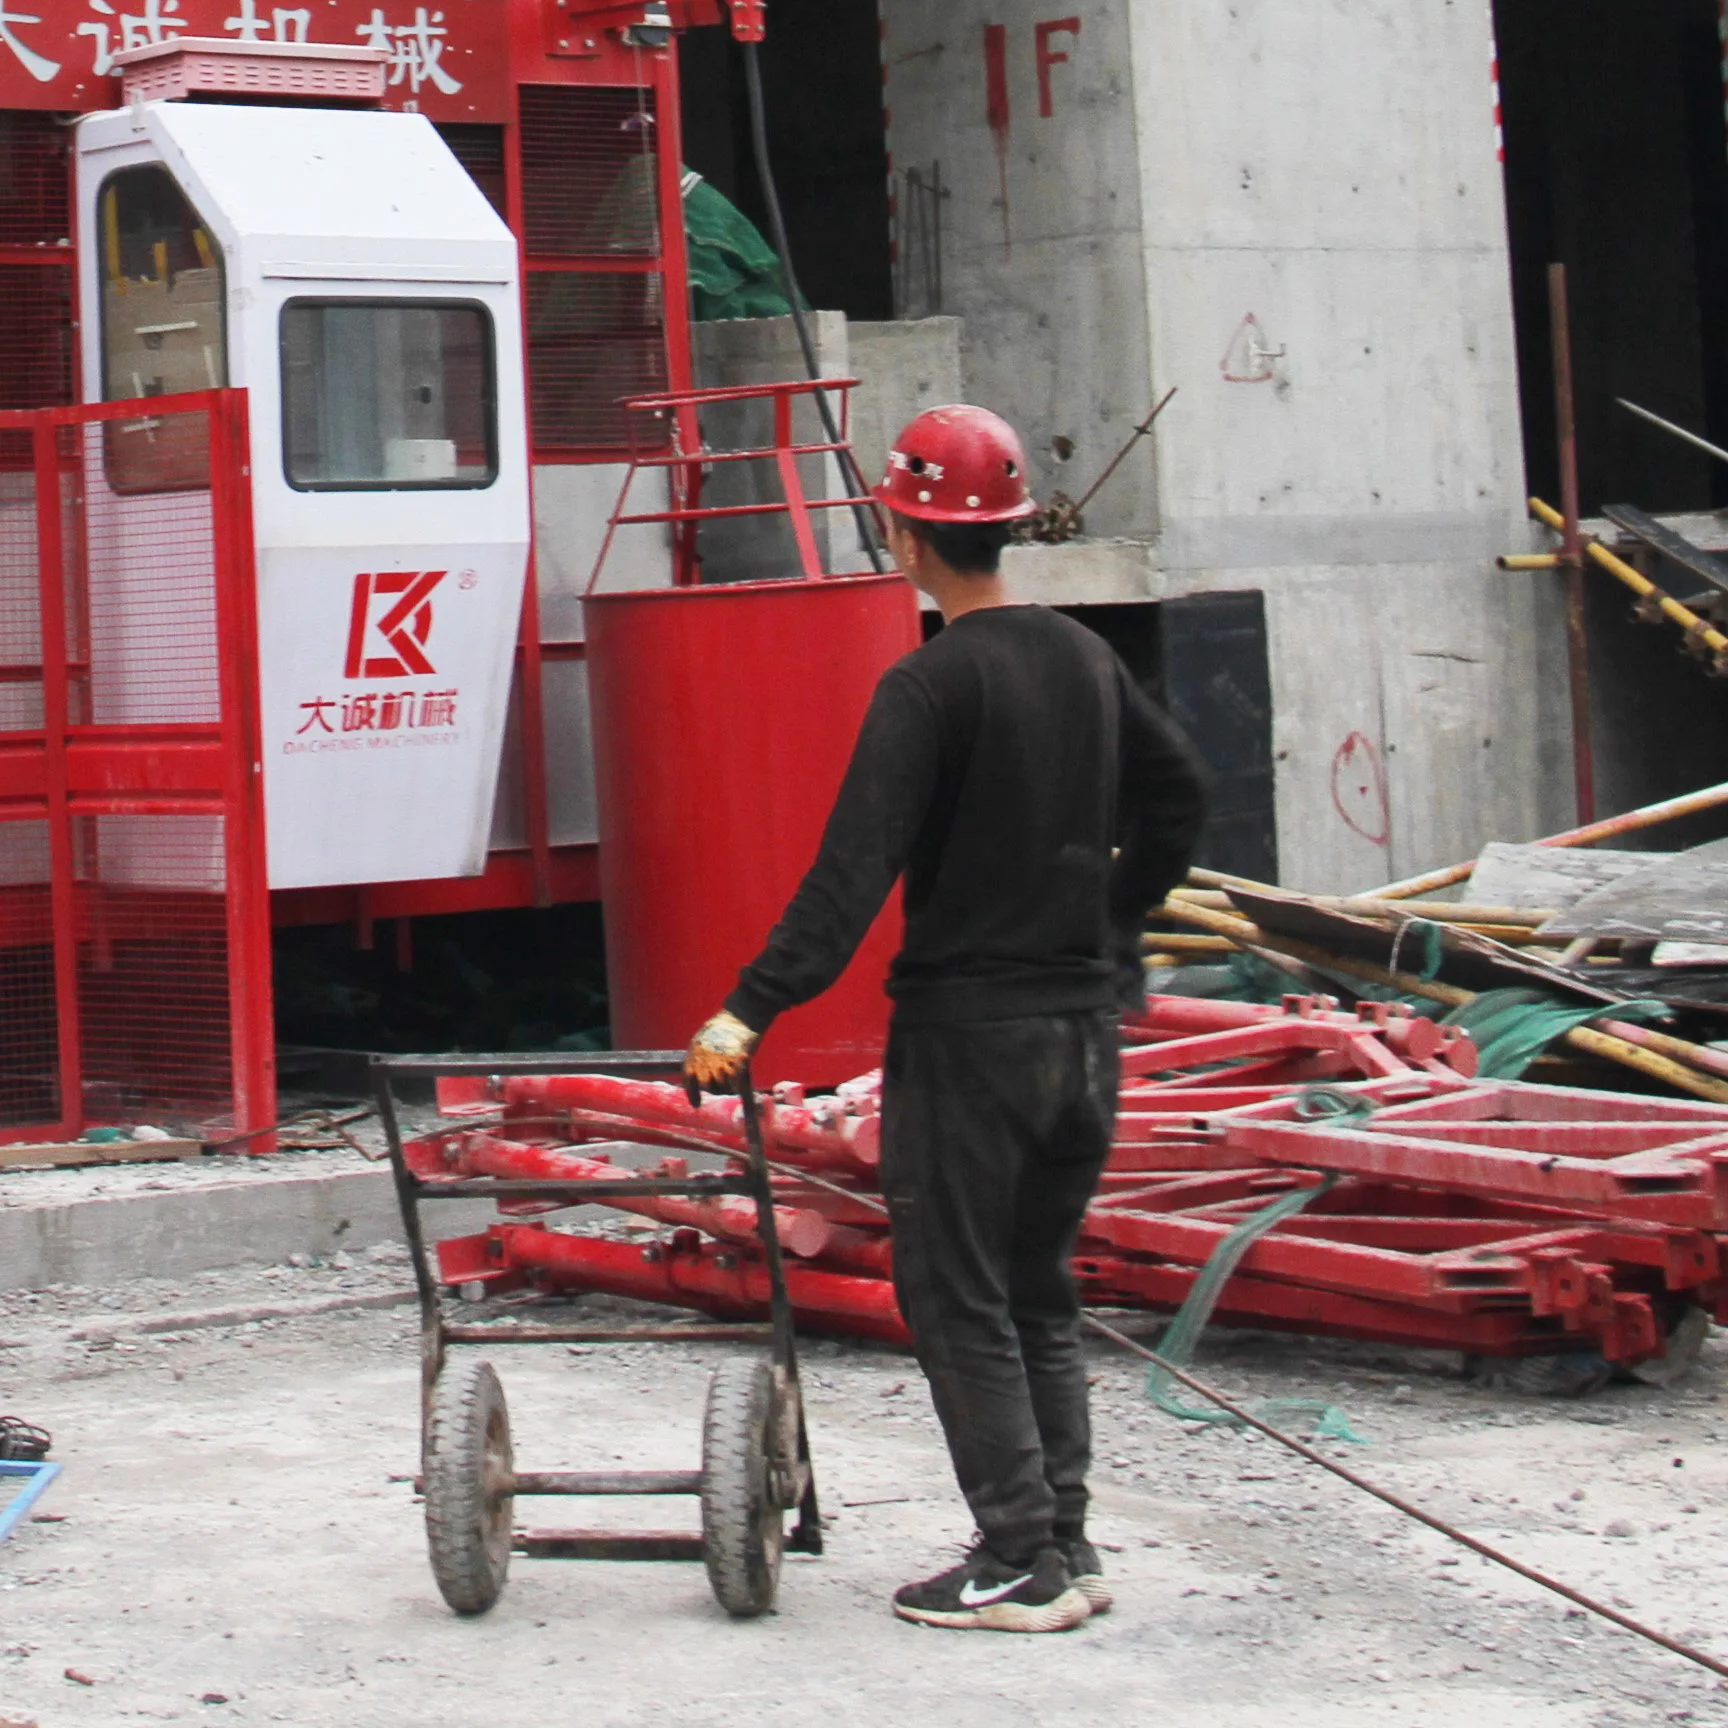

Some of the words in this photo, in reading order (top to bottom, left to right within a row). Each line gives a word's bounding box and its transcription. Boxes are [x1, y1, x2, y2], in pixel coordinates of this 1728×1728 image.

[984, 16, 1082, 130] 1F
[296, 687, 459, 735] 大诚机械
